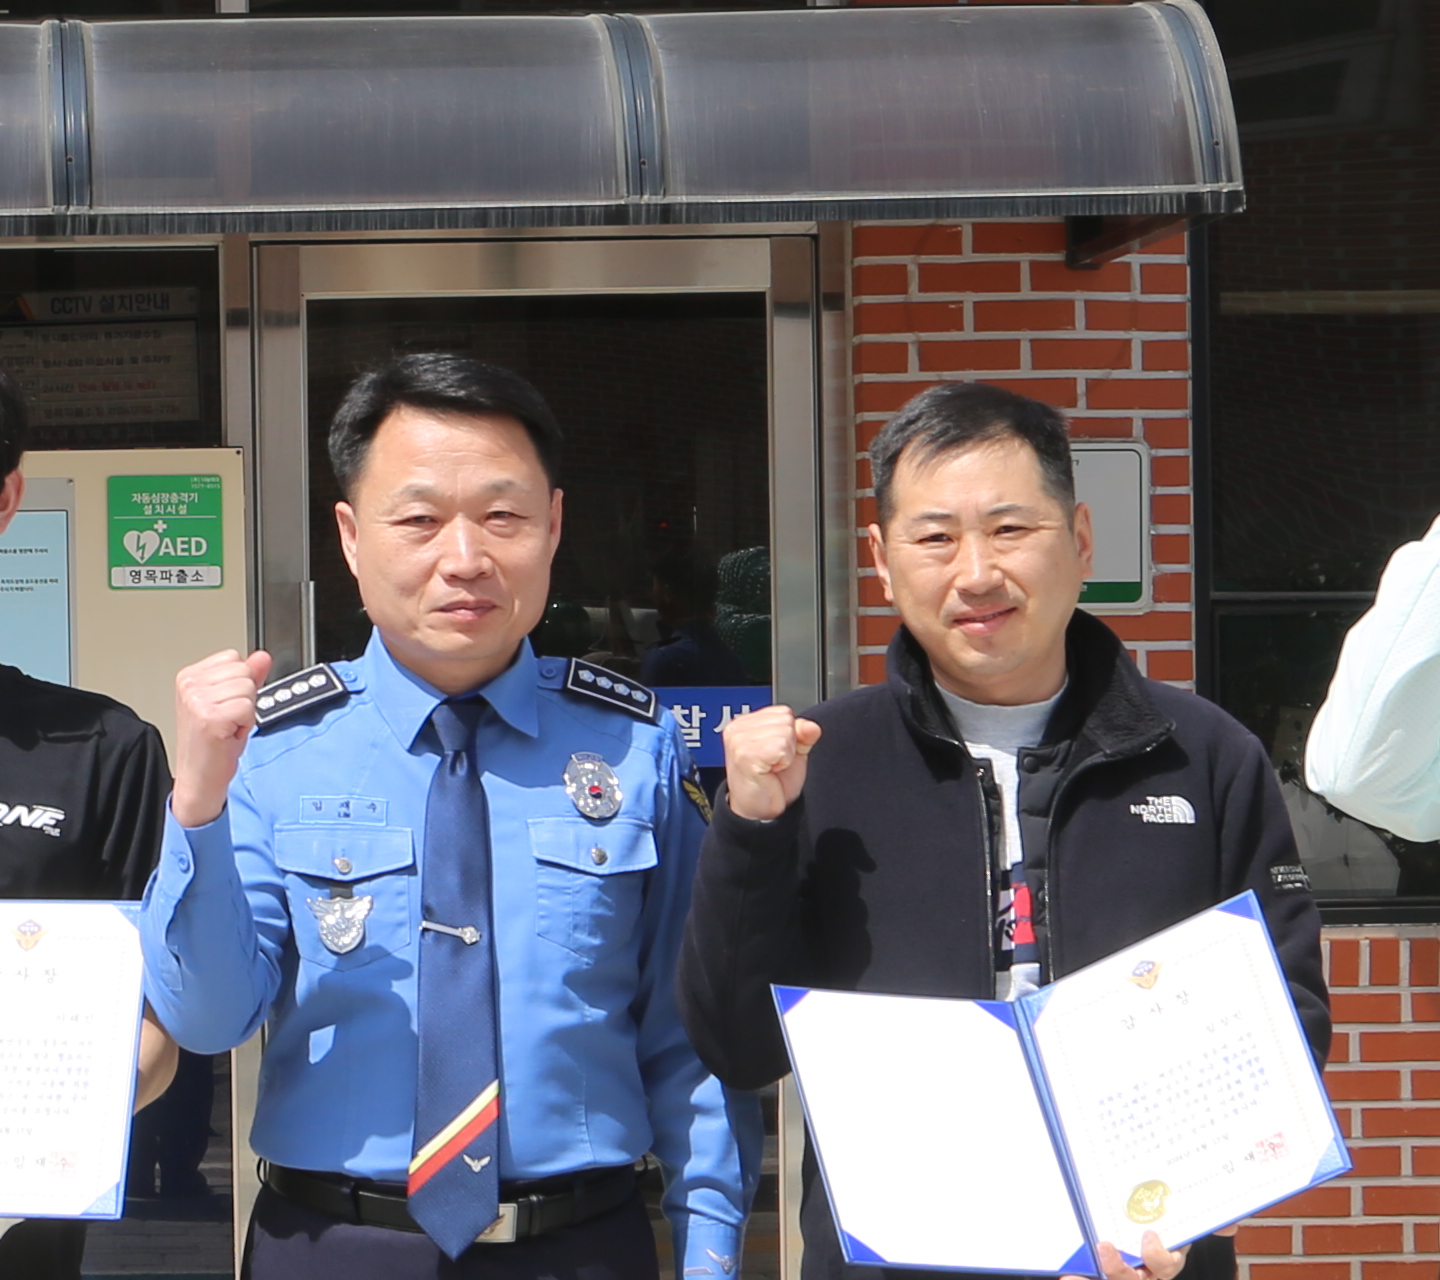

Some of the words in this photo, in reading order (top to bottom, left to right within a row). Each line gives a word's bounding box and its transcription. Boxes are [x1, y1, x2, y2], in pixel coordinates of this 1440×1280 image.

[51, 295, 92, 314] CCTV
[158, 537, 208, 556] AED
[129, 569, 204, 584] 영목파출소
[1146, 796, 1172, 805] THE
[1130, 804, 1173, 815] NORTH
[1142, 813, 1174, 824] FACE
